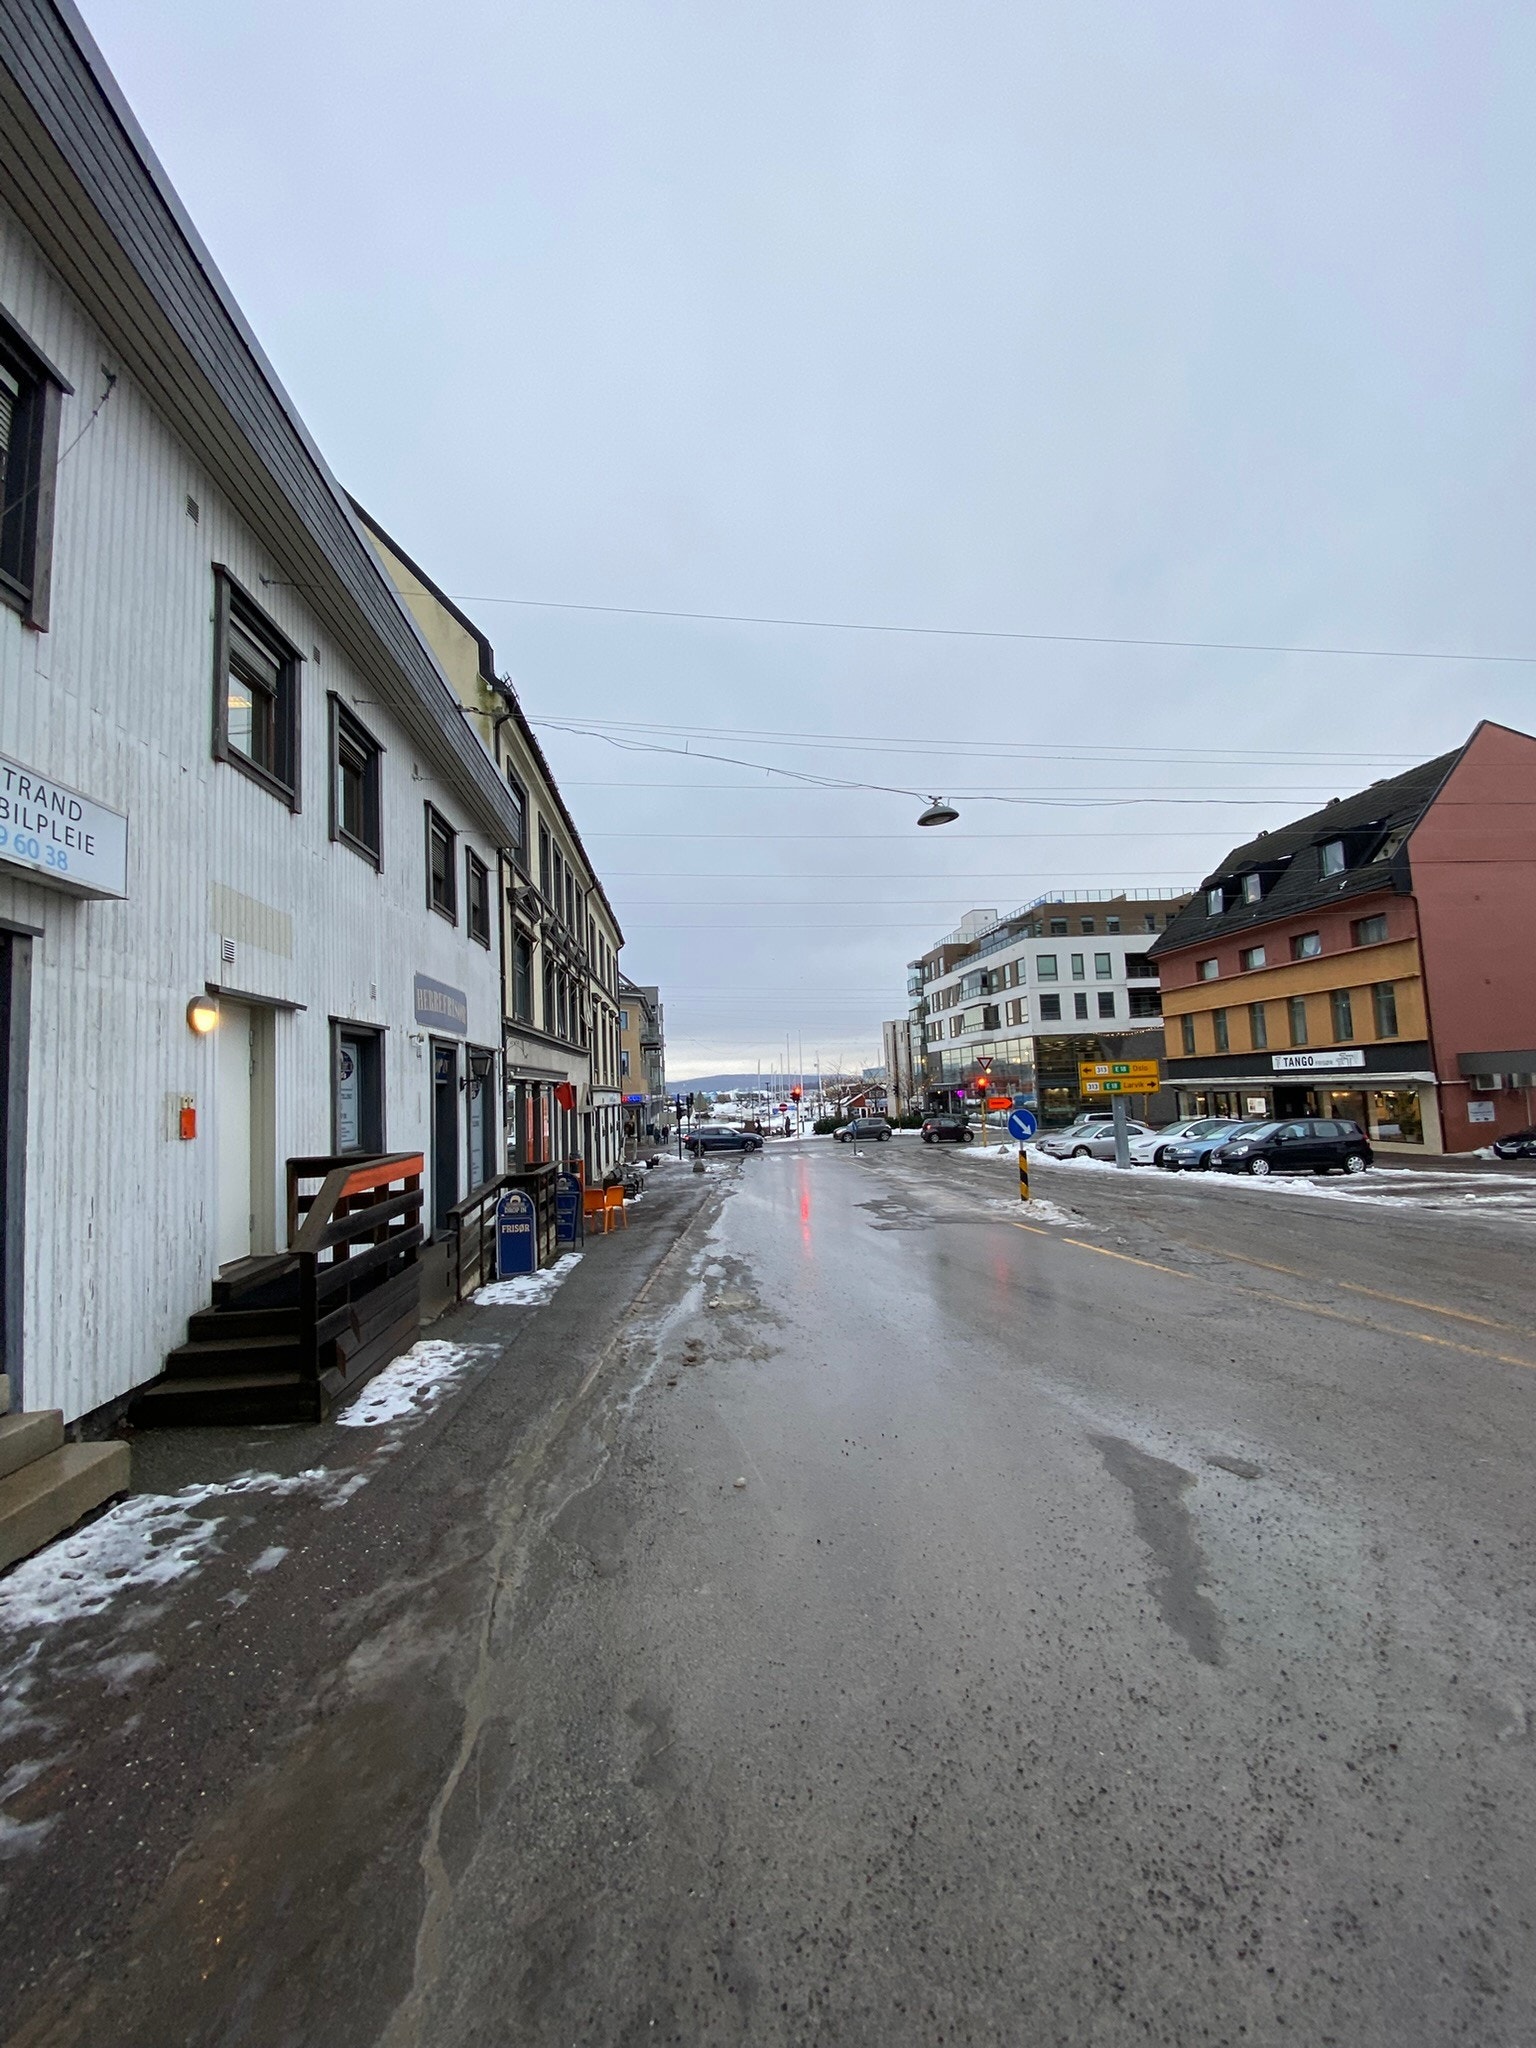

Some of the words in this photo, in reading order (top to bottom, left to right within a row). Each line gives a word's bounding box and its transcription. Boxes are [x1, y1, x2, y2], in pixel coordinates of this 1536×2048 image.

[3, 767, 82, 821] TRAND
[0, 796, 95, 856] BILPLEIE
[14, 833, 39, 860] 60
[45, 845, 69, 871] 38
[1283, 1056, 1314, 1067] TANGO
[1123, 1081, 1144, 1089] Larvik
[502, 1224, 530, 1233] FRISØR
